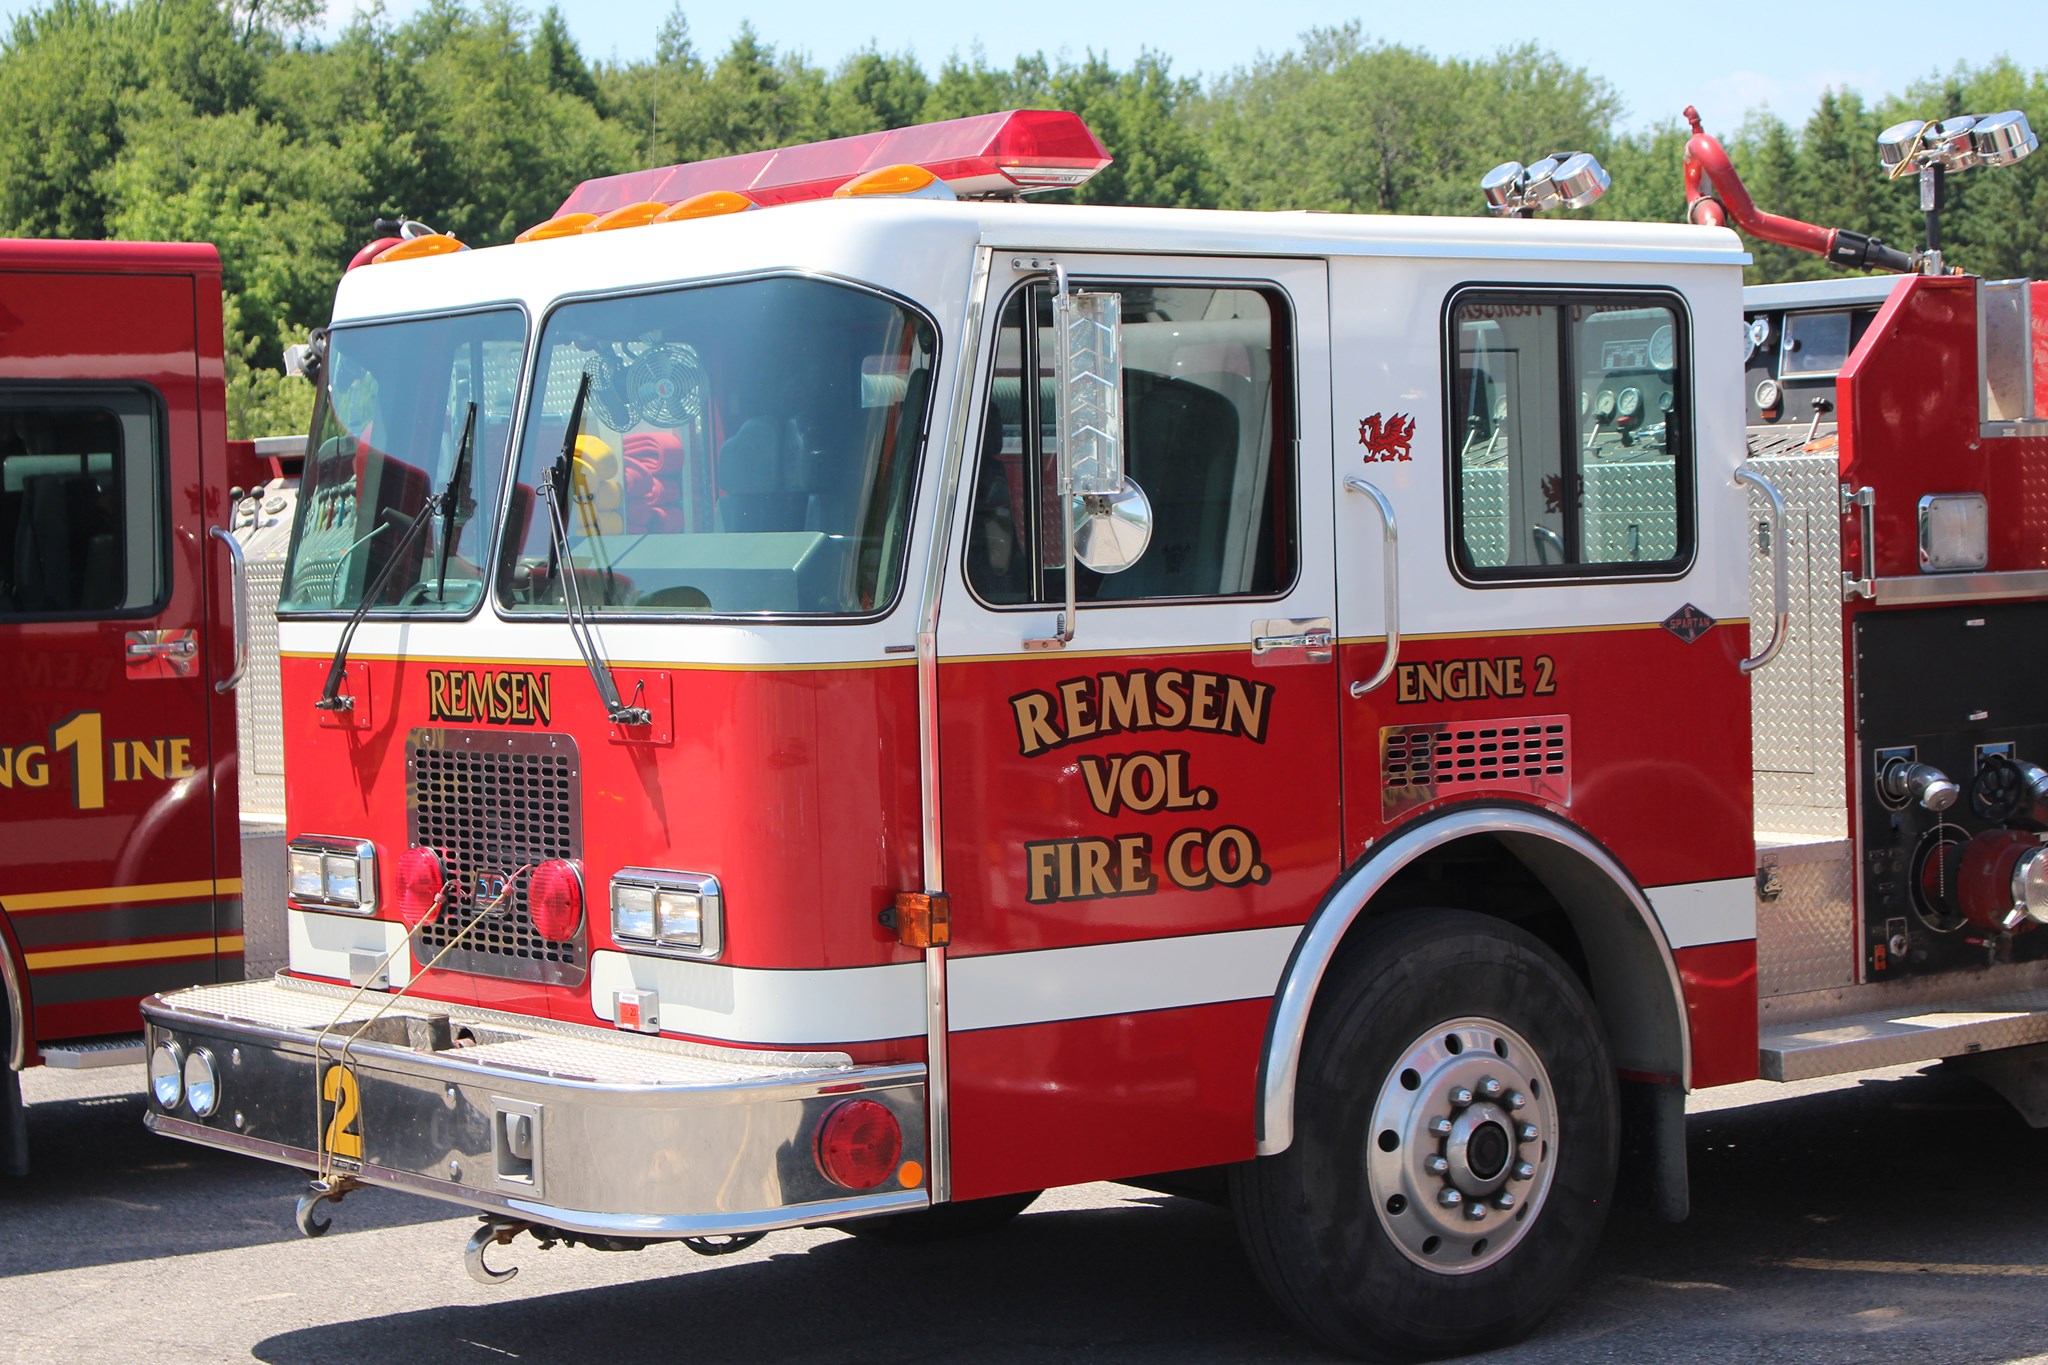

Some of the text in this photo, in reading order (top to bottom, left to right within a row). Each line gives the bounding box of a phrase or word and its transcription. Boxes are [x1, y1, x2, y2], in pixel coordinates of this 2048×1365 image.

[1669, 616, 1711, 630] SPARTAN
[427, 669, 551, 727] REMSEN
[1008, 667, 1275, 758] REMSEN
[1396, 655, 1557, 704] ENGINE 2
[1077, 750, 1218, 818] VOL.
[1025, 824, 1271, 904] FIRE CO.
[321, 1060, 364, 1160] 2
